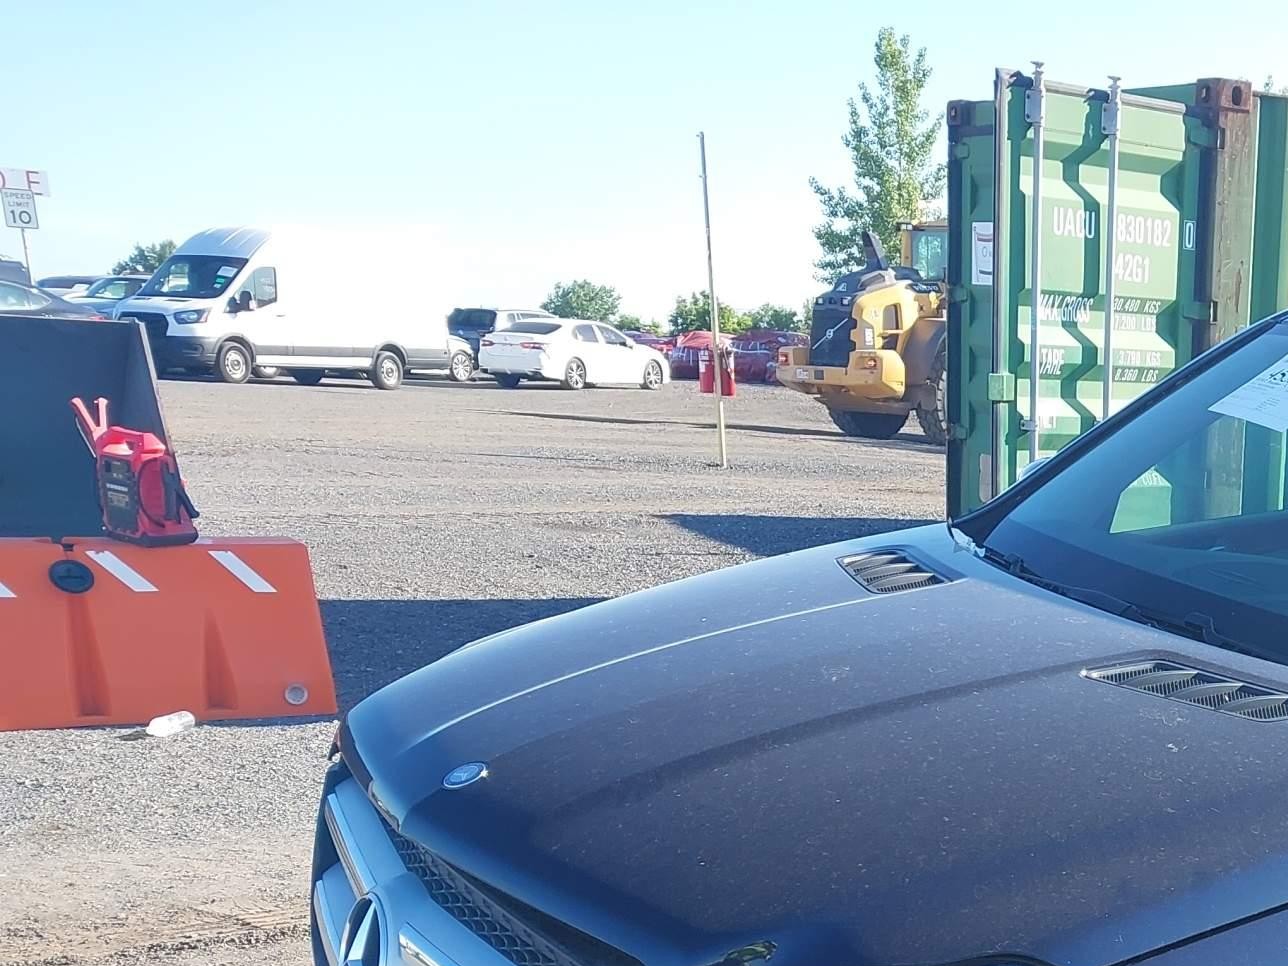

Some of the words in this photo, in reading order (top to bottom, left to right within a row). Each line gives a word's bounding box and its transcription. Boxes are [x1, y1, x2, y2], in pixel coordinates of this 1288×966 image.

[4, 191, 32, 200] SPEED
[10, 210, 32, 225] 10
[1116, 213, 1171, 248] 830182
[1060, 295, 1094, 323] GROSS
[1039, 347, 1065, 375] TARE
